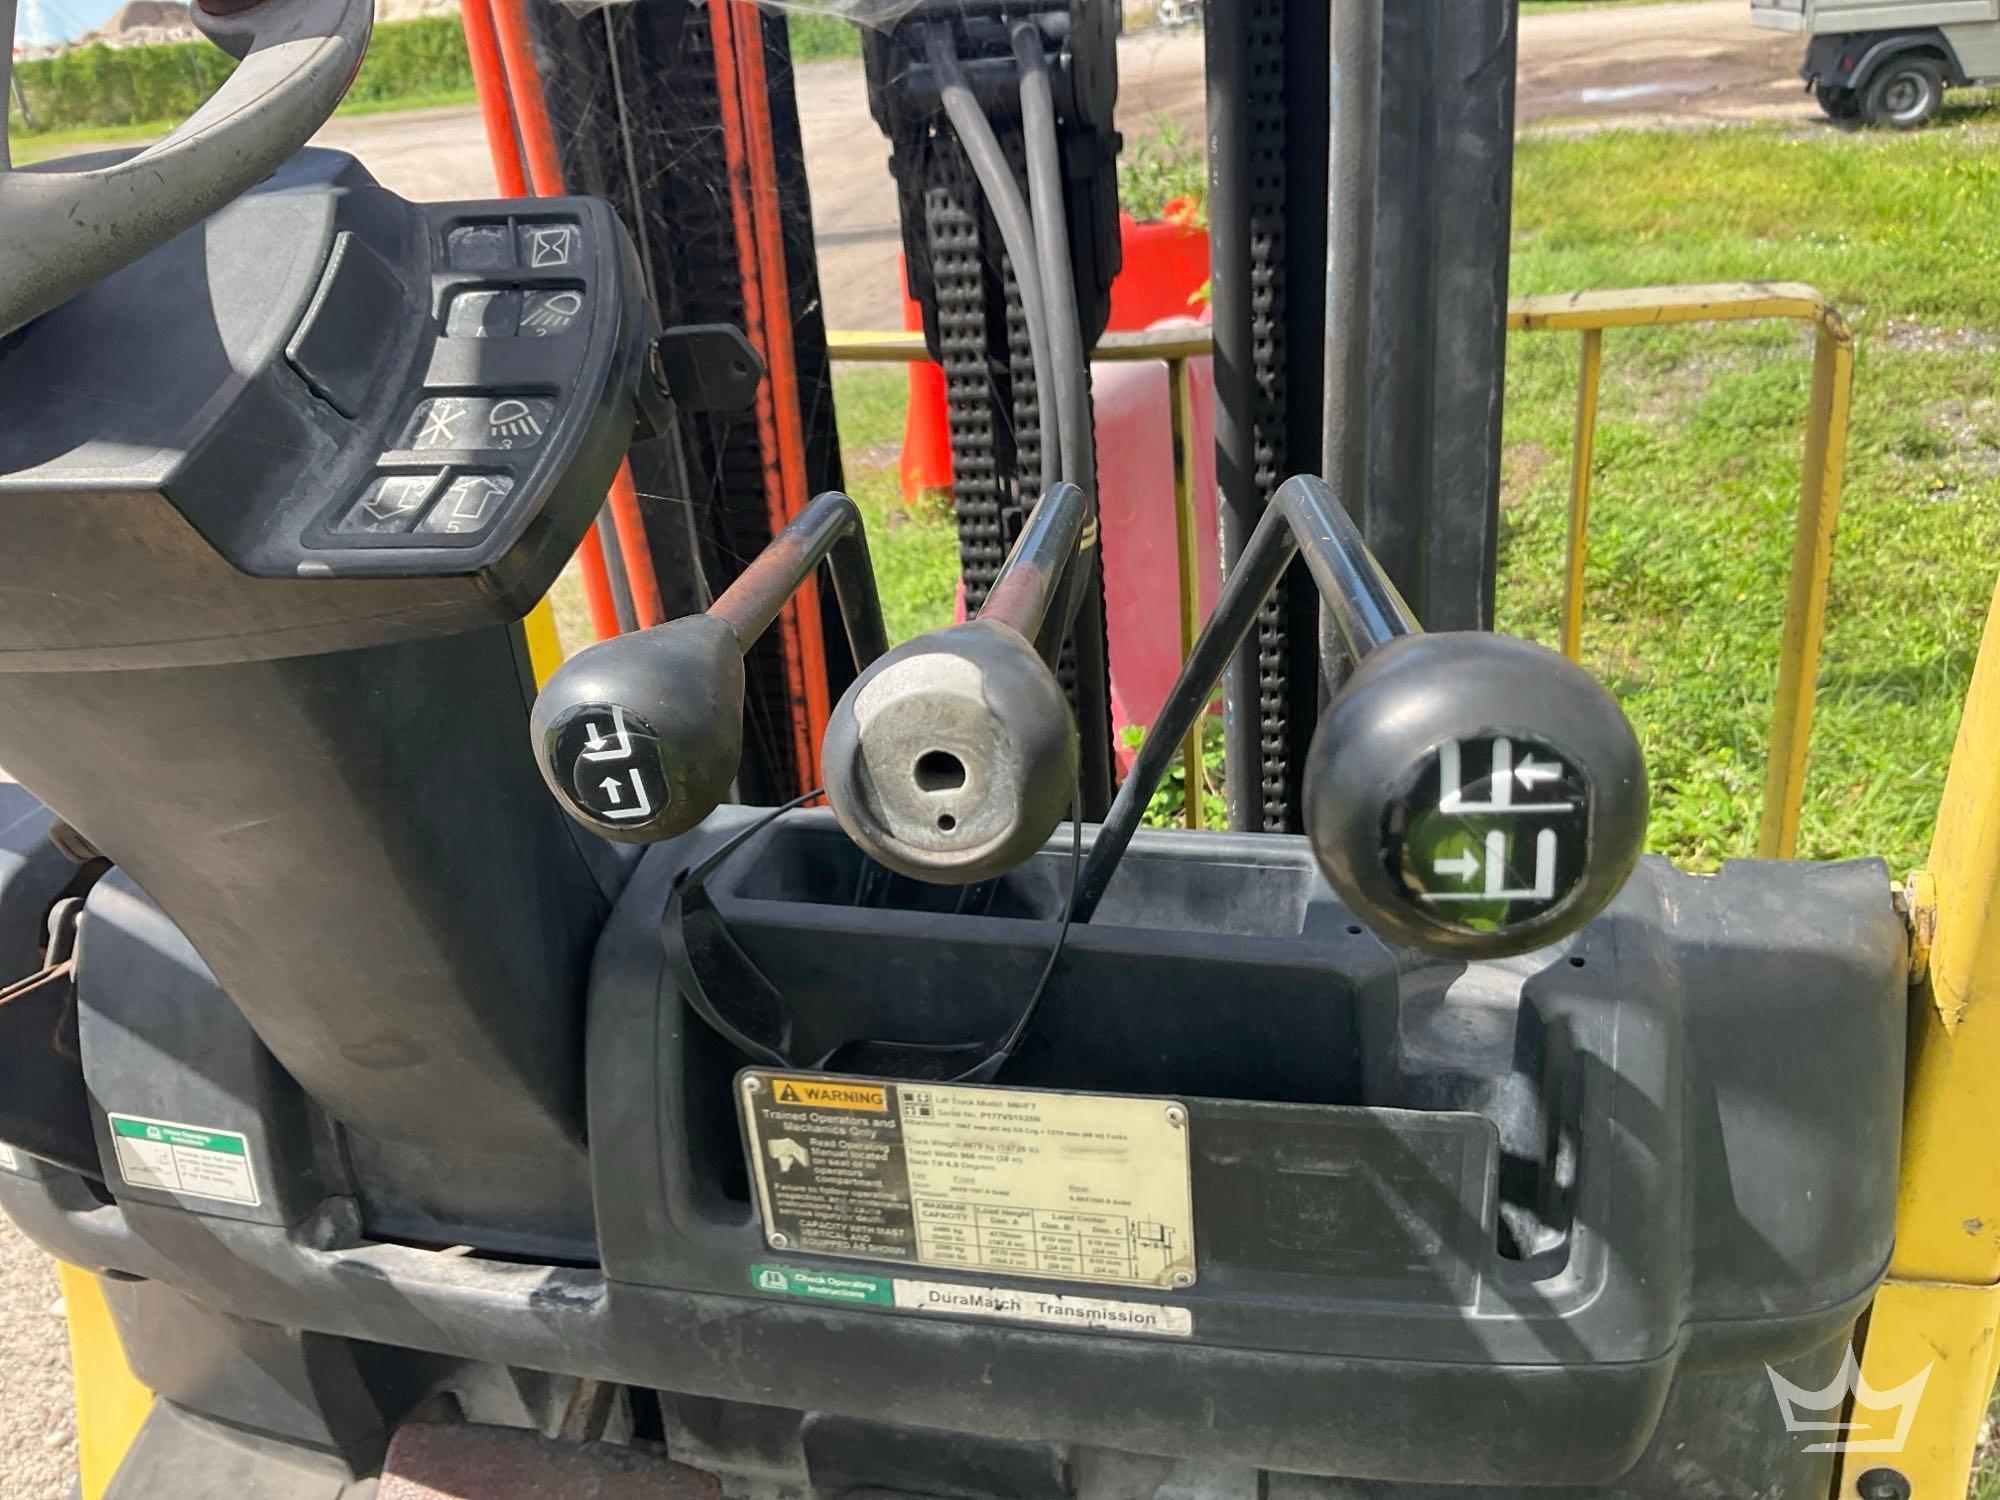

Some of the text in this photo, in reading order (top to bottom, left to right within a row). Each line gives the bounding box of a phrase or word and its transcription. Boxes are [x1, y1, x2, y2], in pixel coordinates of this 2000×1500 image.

[447, 521, 461, 533] 5
[806, 1088, 883, 1104] WARNING
[762, 1109, 896, 1128] Trained Operators and
[784, 1122, 877, 1139] Mechanics Only
[810, 1138, 890, 1153] Read Operating
[811, 1148, 888, 1161] Manual located
[799, 1220, 847, 1231] CAPACITY
[795, 1274, 876, 1292] Check Operating
[808, 1285, 865, 1298] Instructions
[929, 1290, 1157, 1325] DuraMatch Transmission
